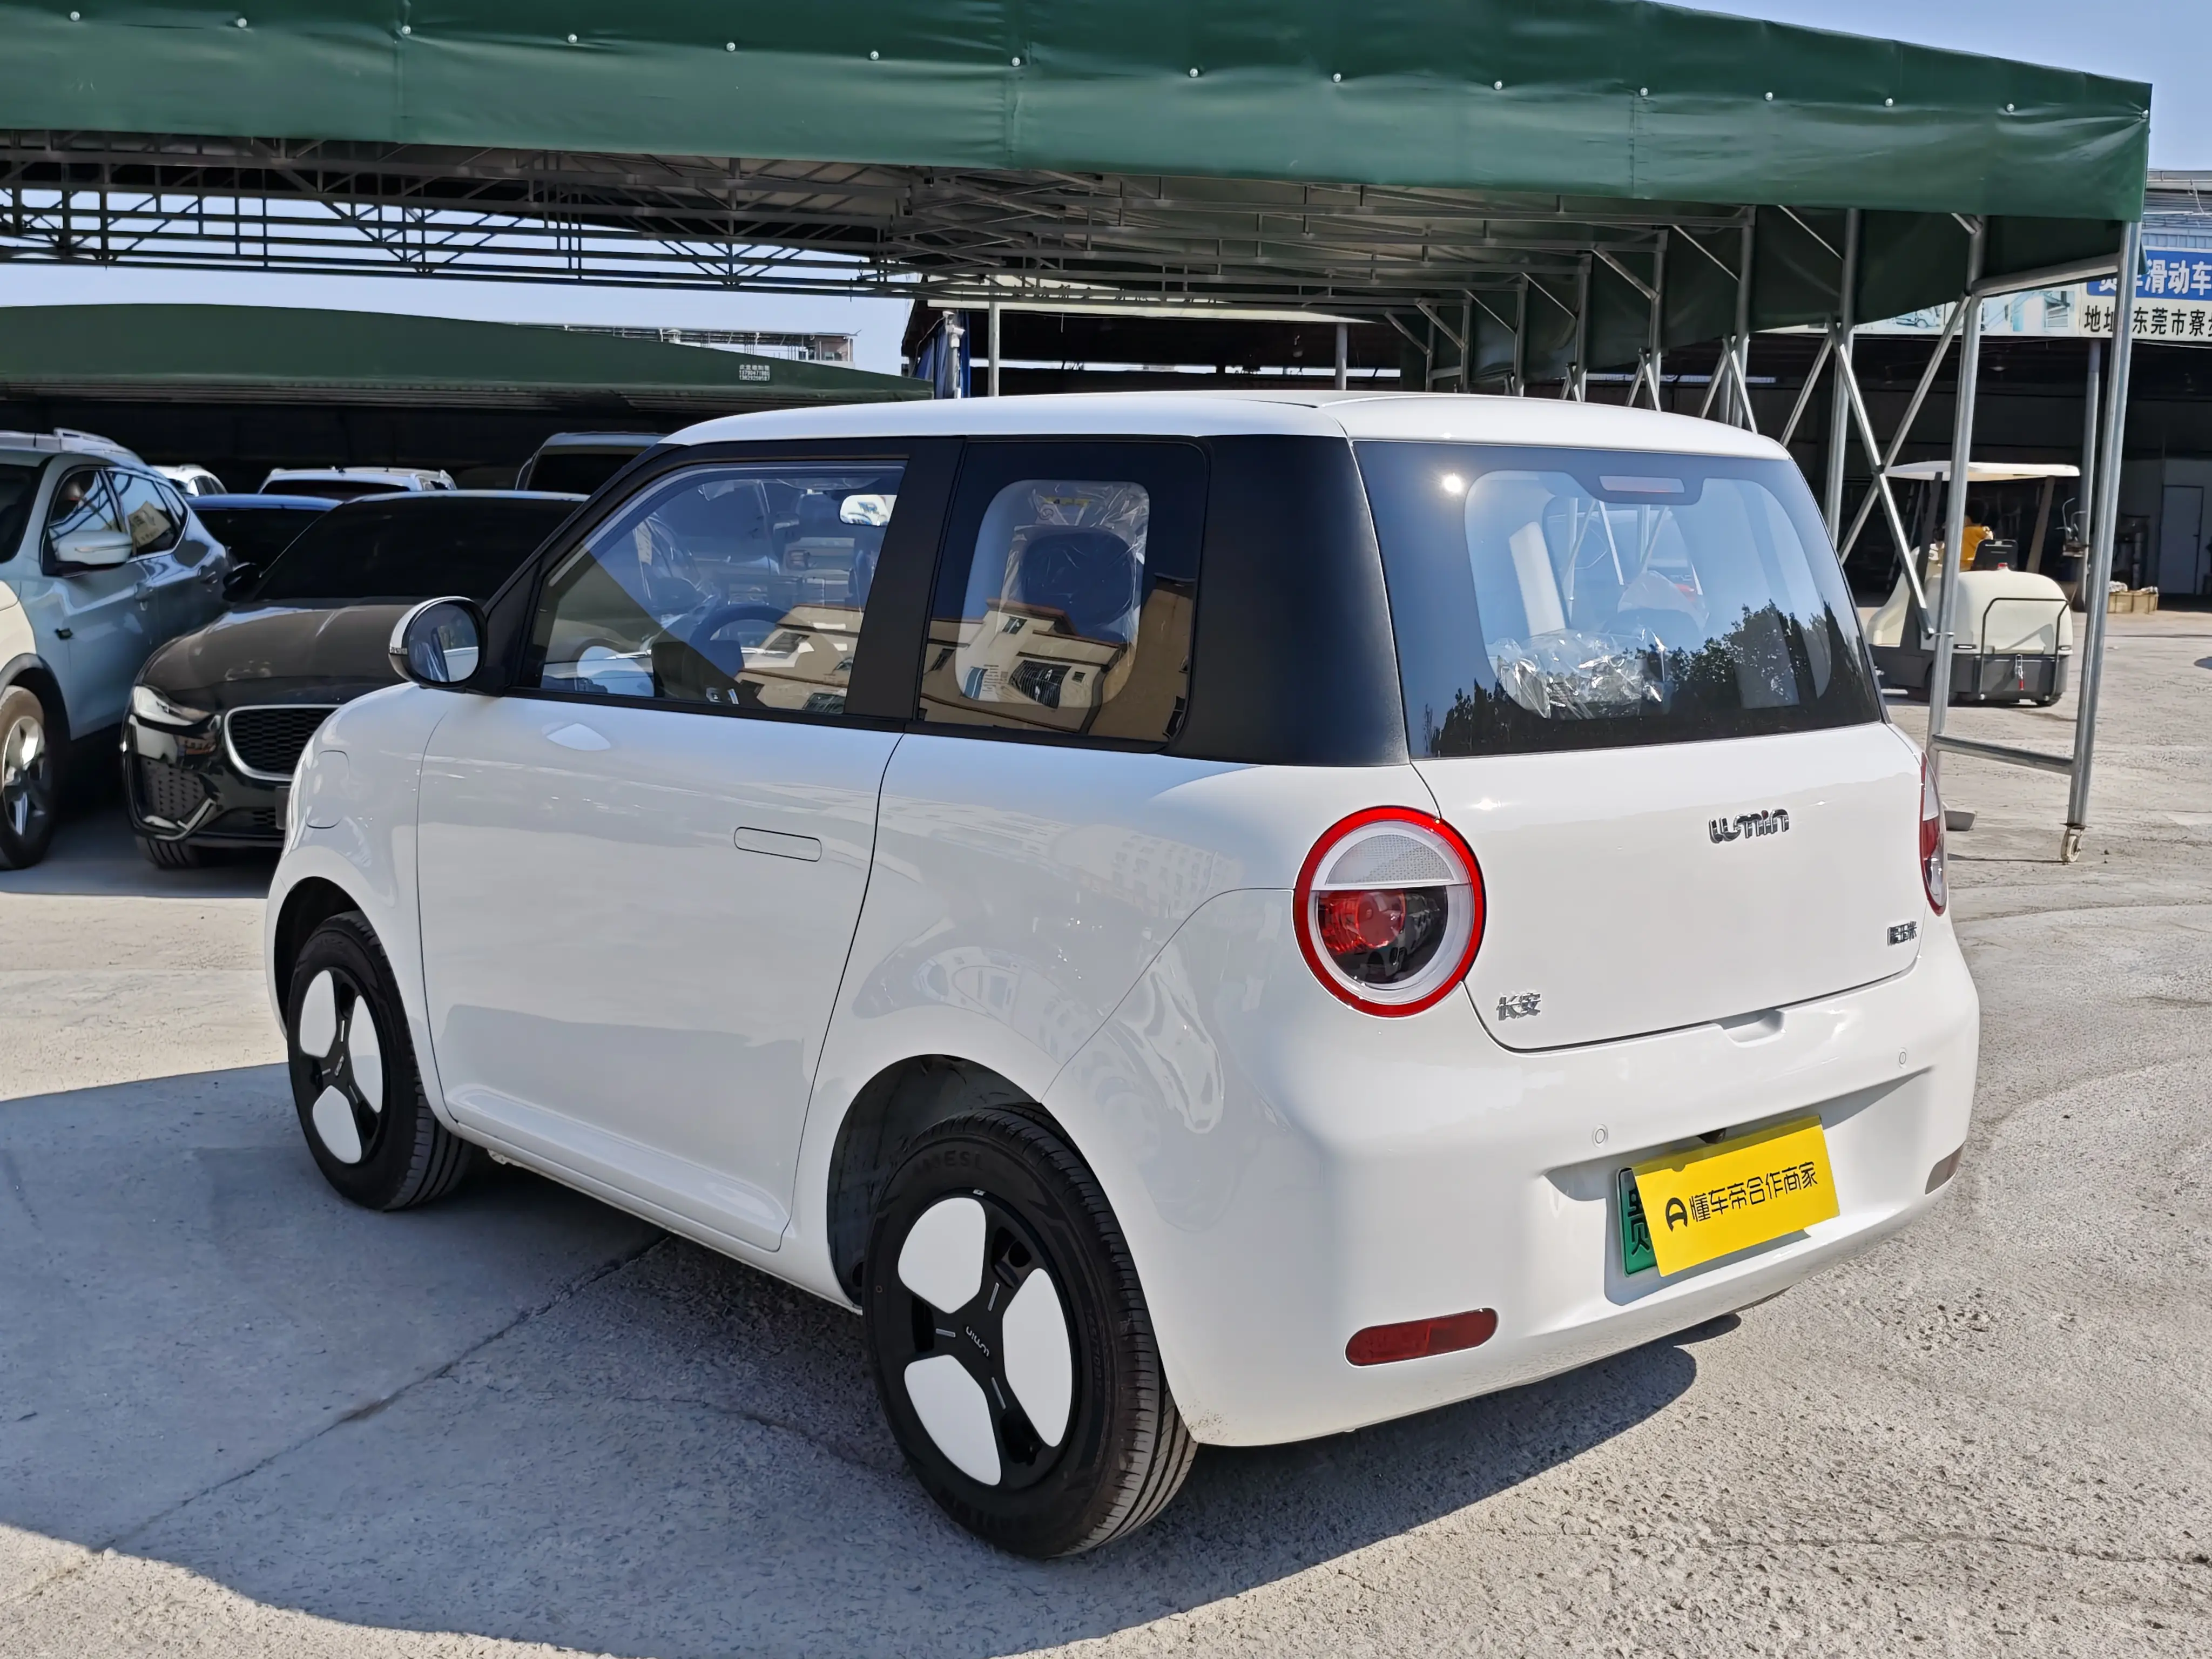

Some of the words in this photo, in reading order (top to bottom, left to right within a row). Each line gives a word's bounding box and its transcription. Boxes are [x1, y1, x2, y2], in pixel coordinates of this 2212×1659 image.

[1689, 1161, 1818, 1223] 懂车帝合作商家
